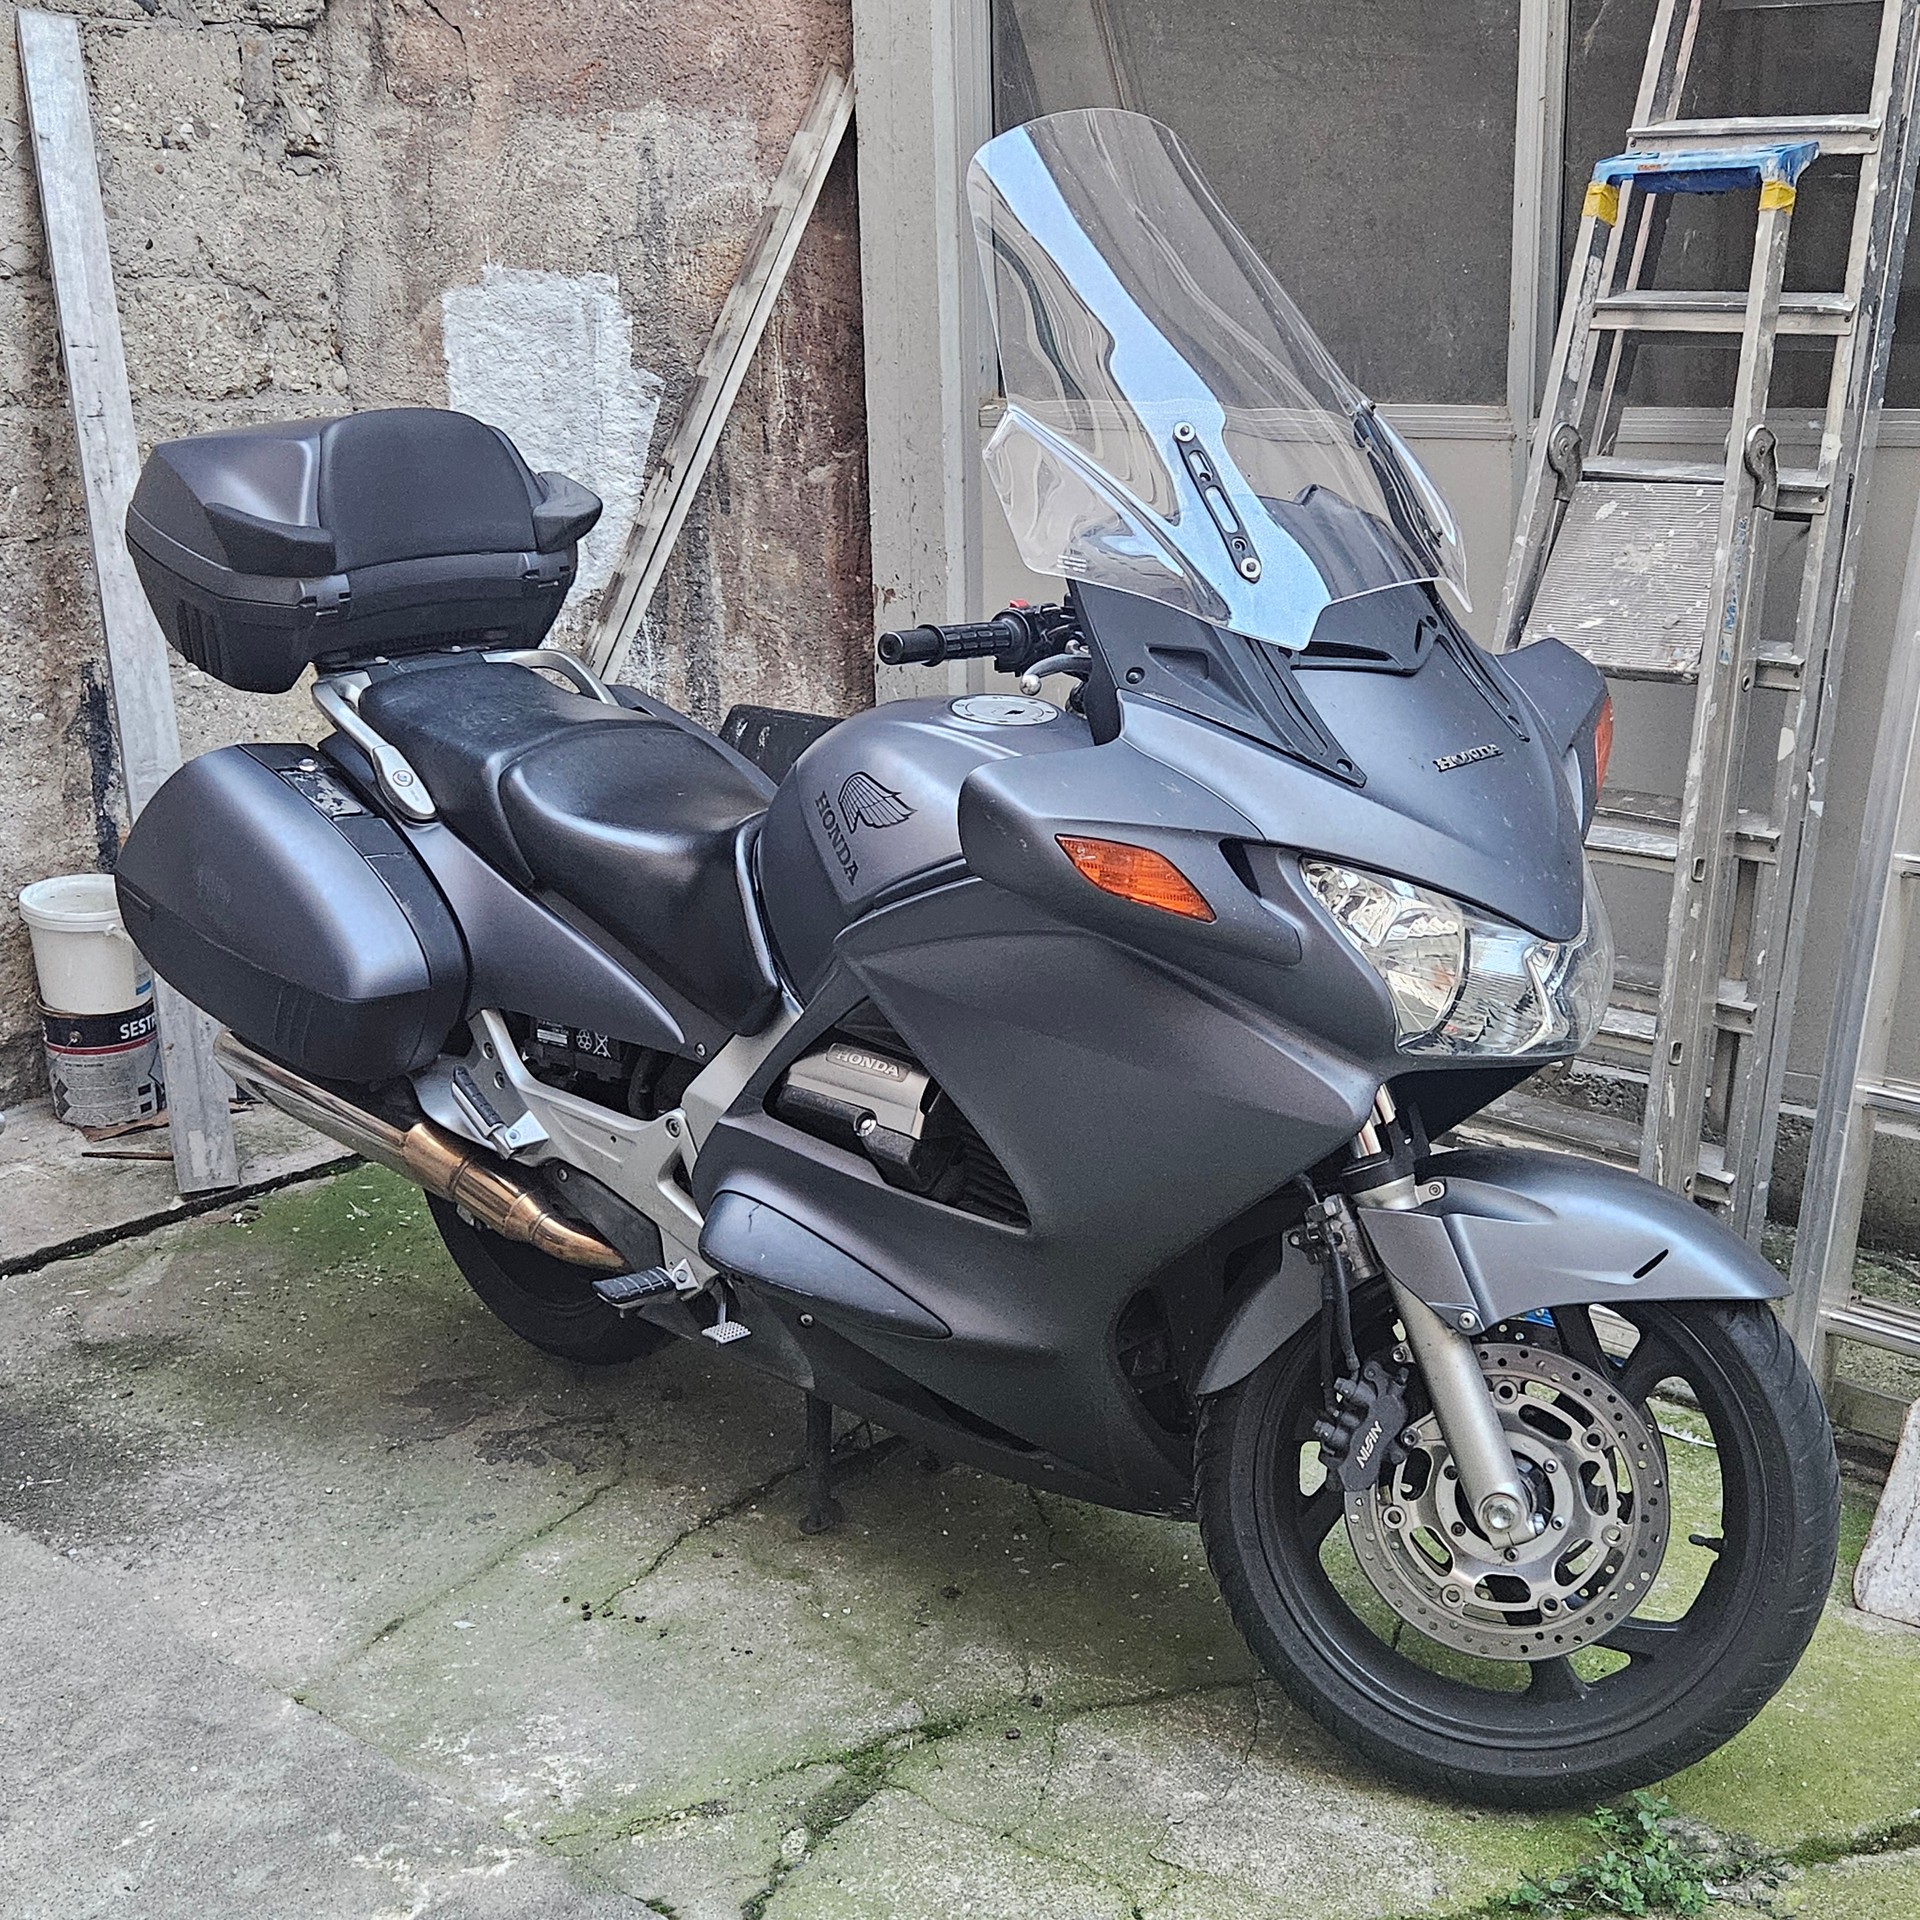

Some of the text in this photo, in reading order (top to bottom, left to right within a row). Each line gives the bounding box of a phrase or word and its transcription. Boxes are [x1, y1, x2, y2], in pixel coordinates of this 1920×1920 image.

[1432, 743, 1503, 772] HONDA
[815, 790, 859, 886] HONDA
[836, 1050, 899, 1077] HONDA
